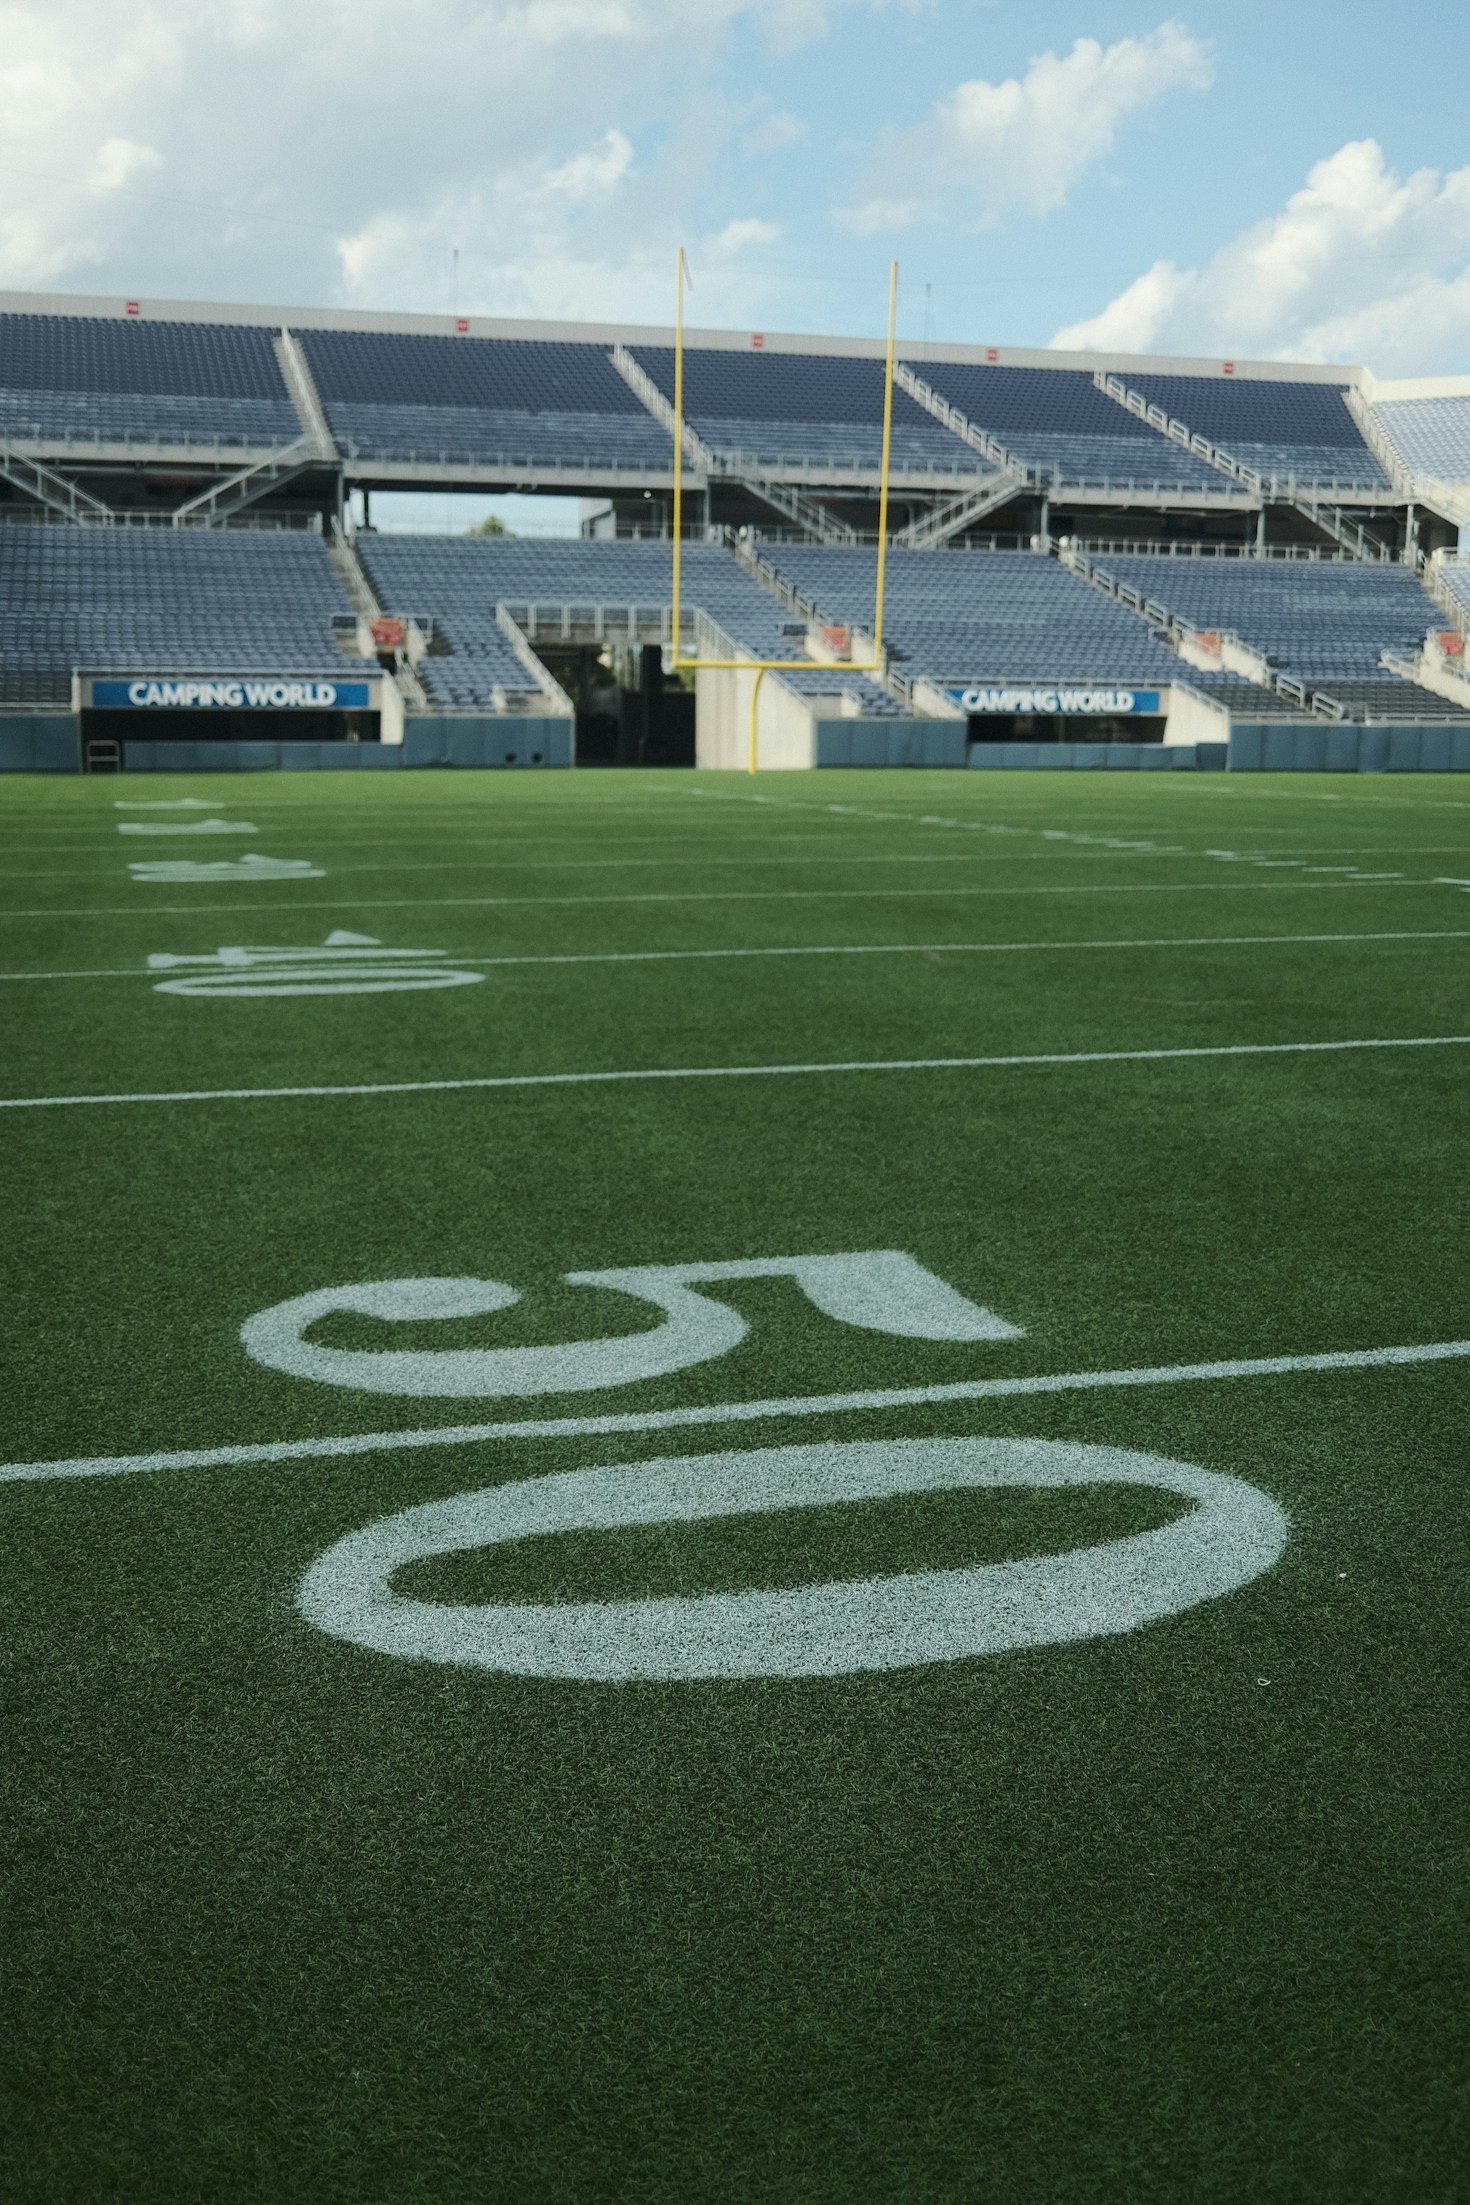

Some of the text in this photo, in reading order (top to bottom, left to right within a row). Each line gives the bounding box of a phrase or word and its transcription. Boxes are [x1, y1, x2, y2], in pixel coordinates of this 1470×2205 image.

[127, 681, 338, 708] CAMPING WORLD
[961, 688, 1136, 713] CAMPING WORLD
[239, 1249, 1291, 1683] 50
